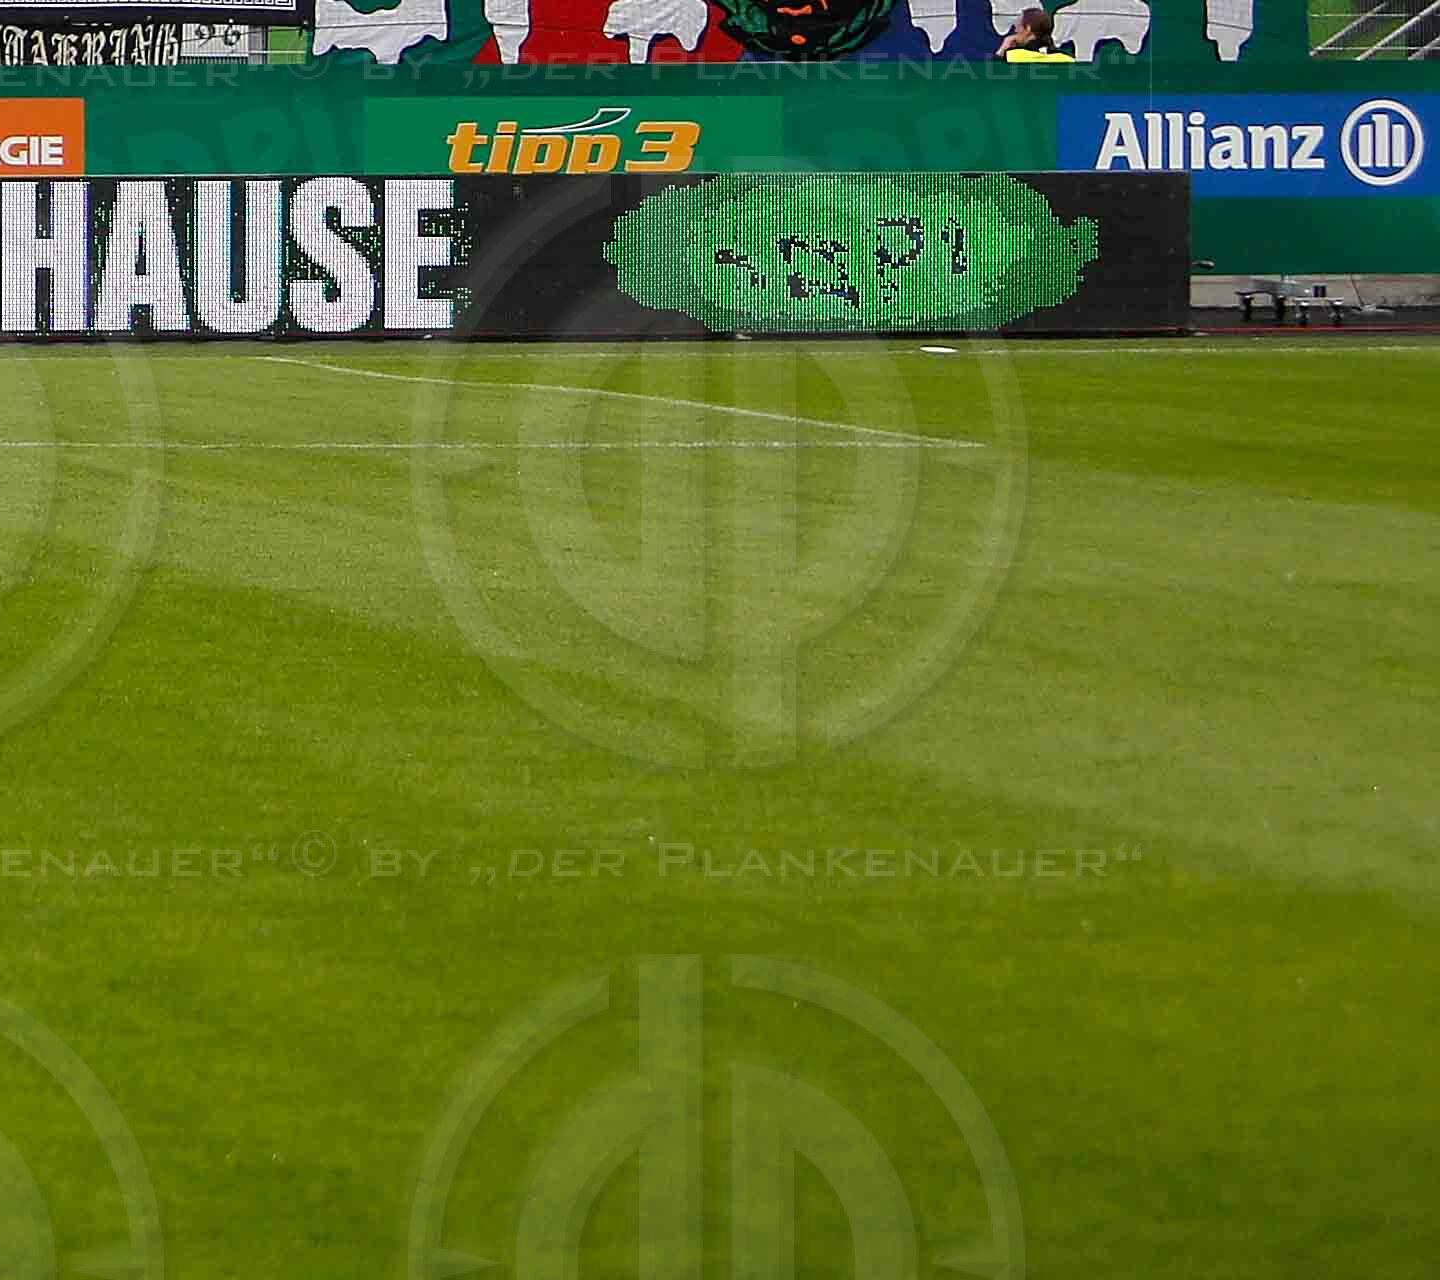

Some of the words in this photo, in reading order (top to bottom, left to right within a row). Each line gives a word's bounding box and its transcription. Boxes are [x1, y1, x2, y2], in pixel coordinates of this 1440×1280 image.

[447, 120, 622, 173] tipp
[624, 121, 701, 172] 3
[1095, 111, 1325, 171] Allianz
